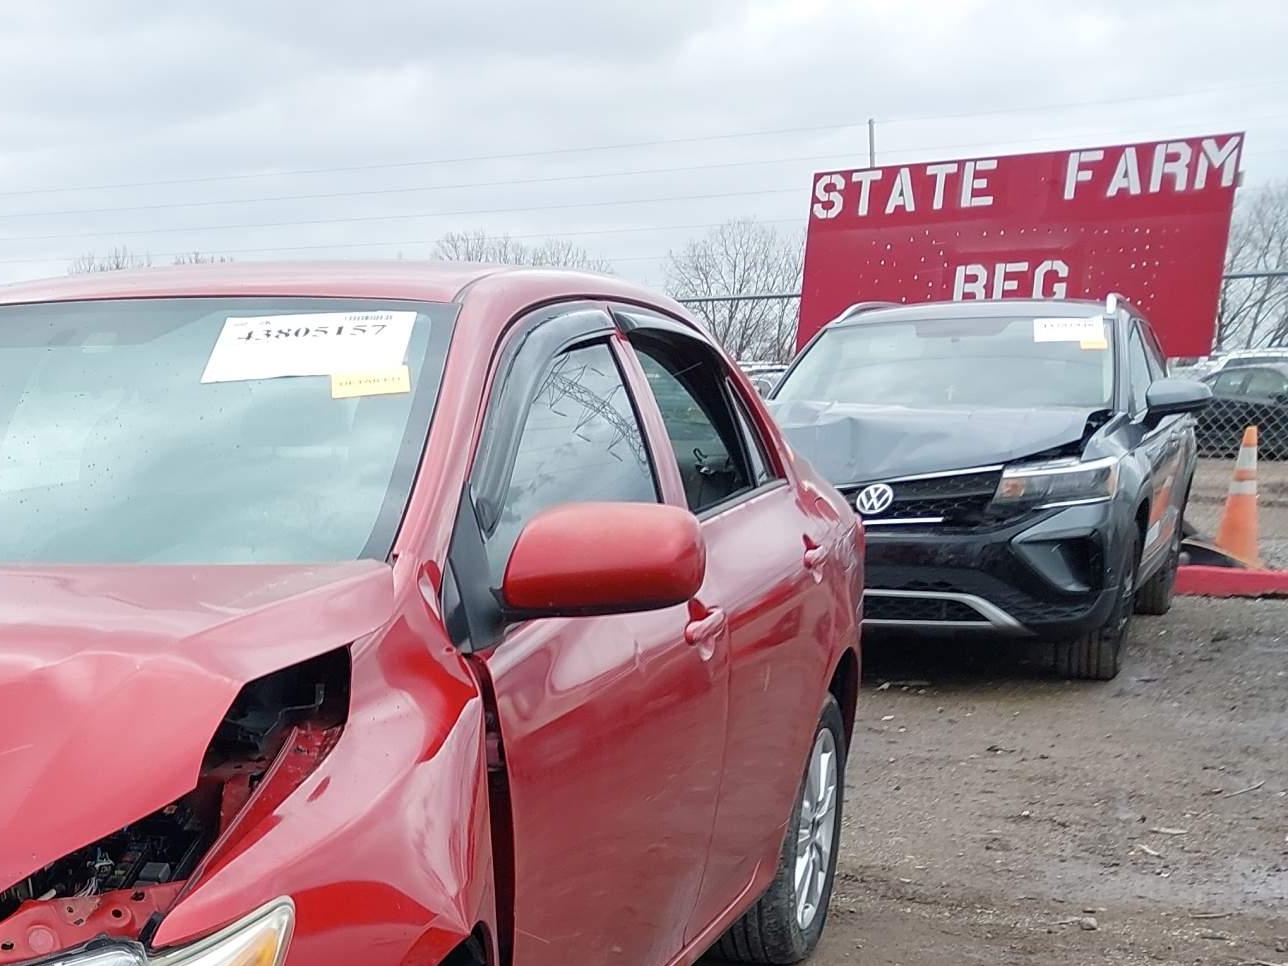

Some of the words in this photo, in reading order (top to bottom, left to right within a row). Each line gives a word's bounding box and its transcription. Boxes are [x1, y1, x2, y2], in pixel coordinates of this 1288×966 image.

[812, 159, 998, 220] STATE
[1064, 135, 1240, 201] FARM
[237, 323, 388, 344] 43805157
